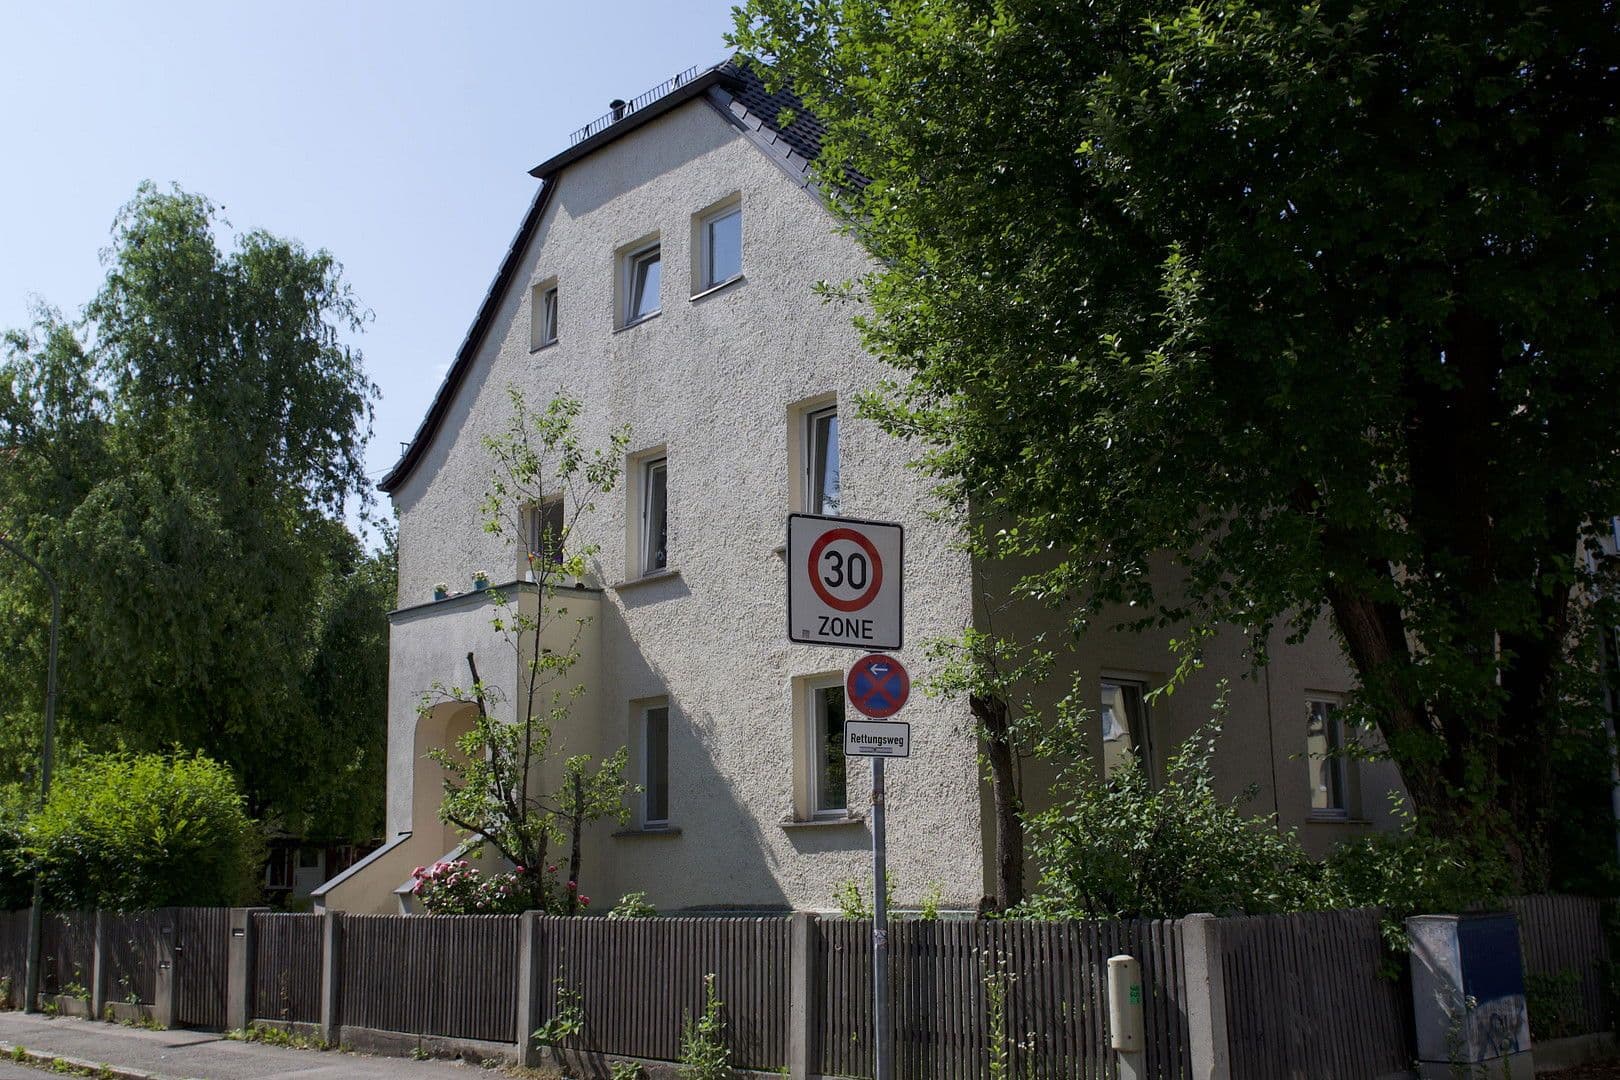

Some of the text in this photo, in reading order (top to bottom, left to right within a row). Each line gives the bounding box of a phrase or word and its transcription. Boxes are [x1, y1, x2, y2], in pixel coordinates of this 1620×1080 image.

[824, 550, 867, 590] 30
[818, 615, 873, 639] ZONE
[850, 733, 904, 747] Rettungsweg
